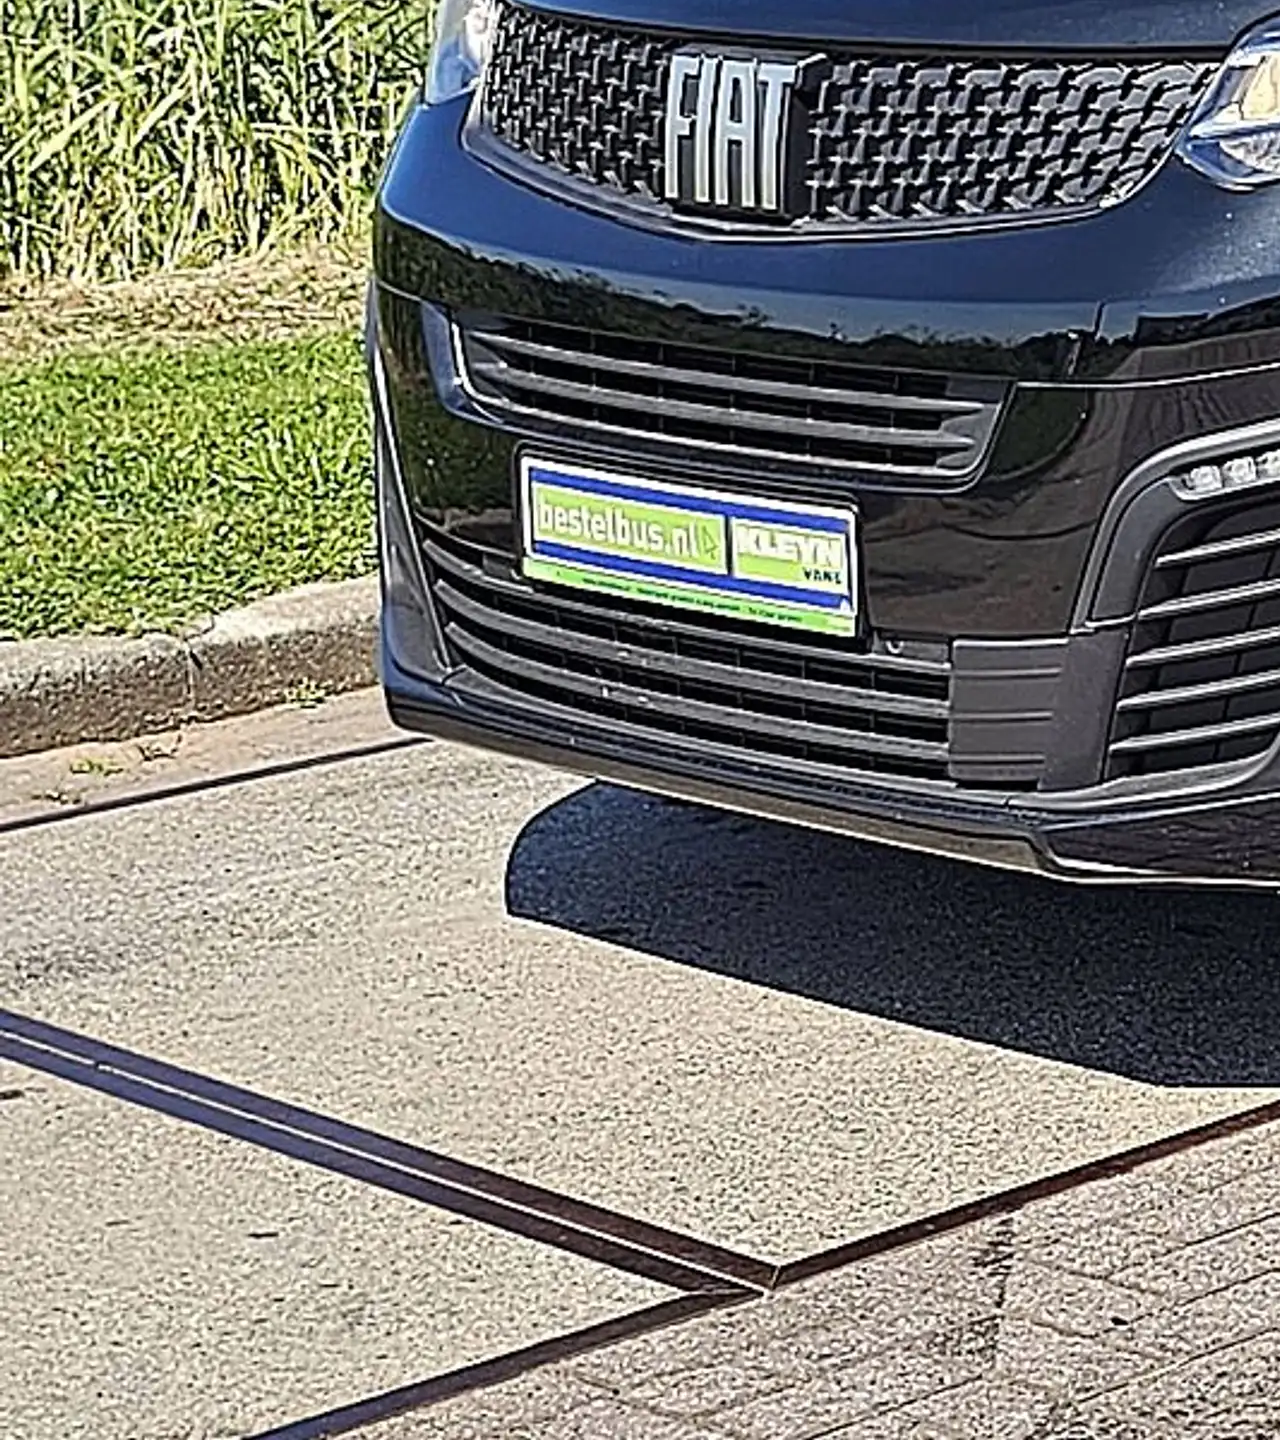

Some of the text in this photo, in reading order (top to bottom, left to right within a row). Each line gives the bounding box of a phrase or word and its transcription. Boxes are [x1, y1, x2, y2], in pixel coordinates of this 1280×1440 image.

[664, 54, 797, 210] FIAT
[539, 494, 698, 557] bestelbus.nl
[736, 524, 843, 569] KLEYN
